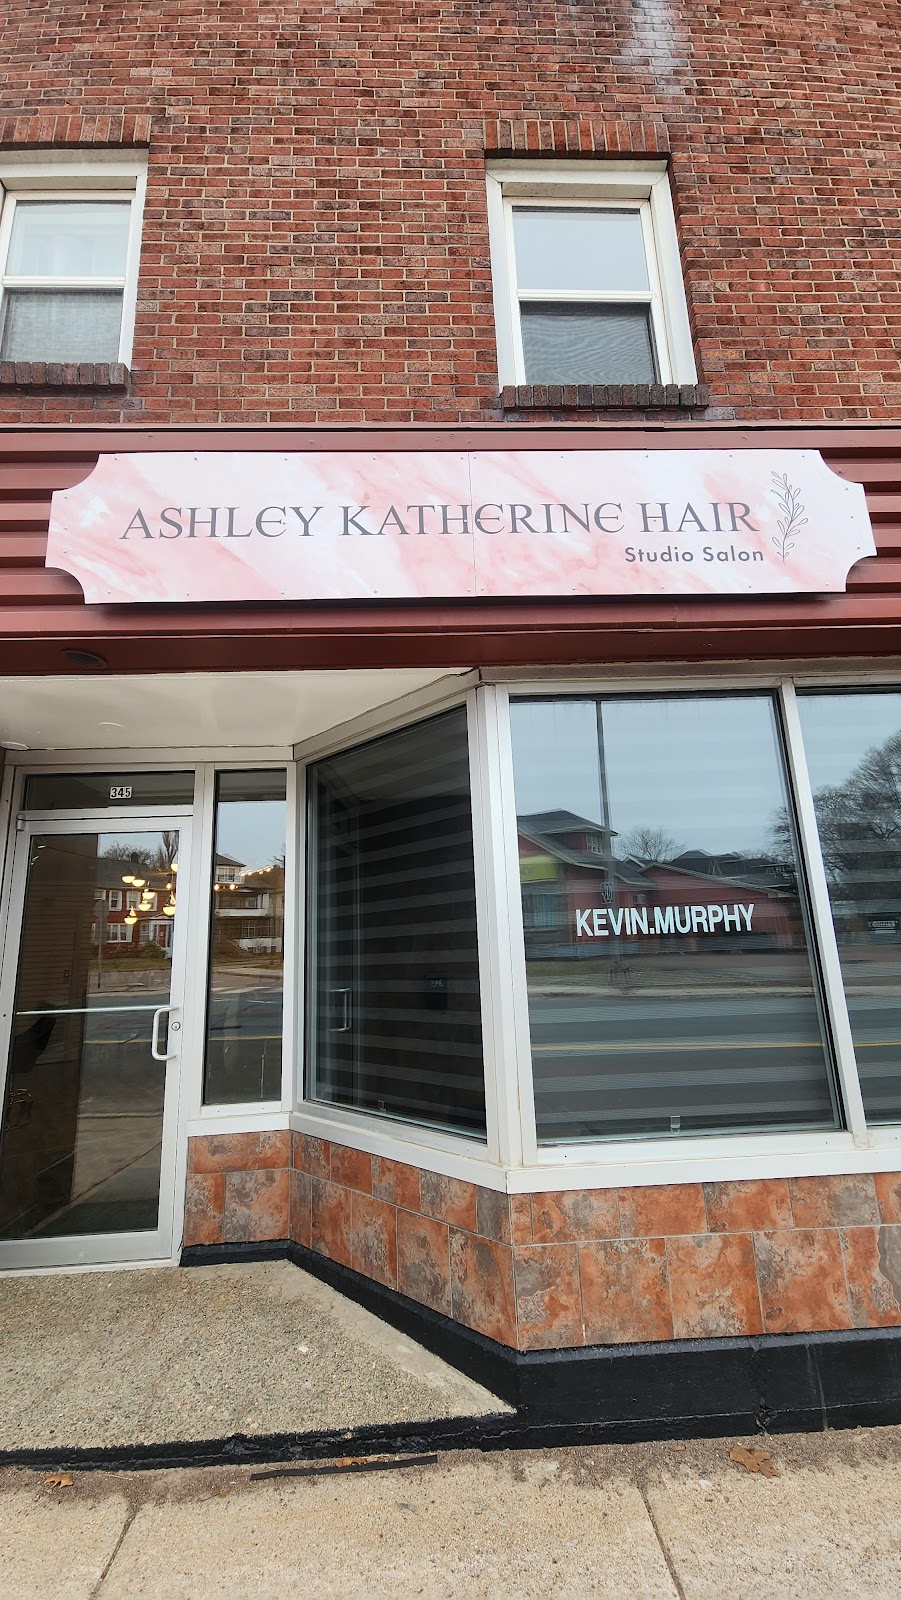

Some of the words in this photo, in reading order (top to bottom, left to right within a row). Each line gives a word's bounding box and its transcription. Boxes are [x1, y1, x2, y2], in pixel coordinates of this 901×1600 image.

[119, 506, 324, 540] ASHLEY
[339, 502, 625, 537] KATHERINE
[637, 501, 761, 533] HAIR
[624, 546, 694, 563] Studio
[702, 545, 765, 562] Salon
[110, 787, 132, 798] 345
[575, 903, 755, 937] KEVIN.MURPHY
